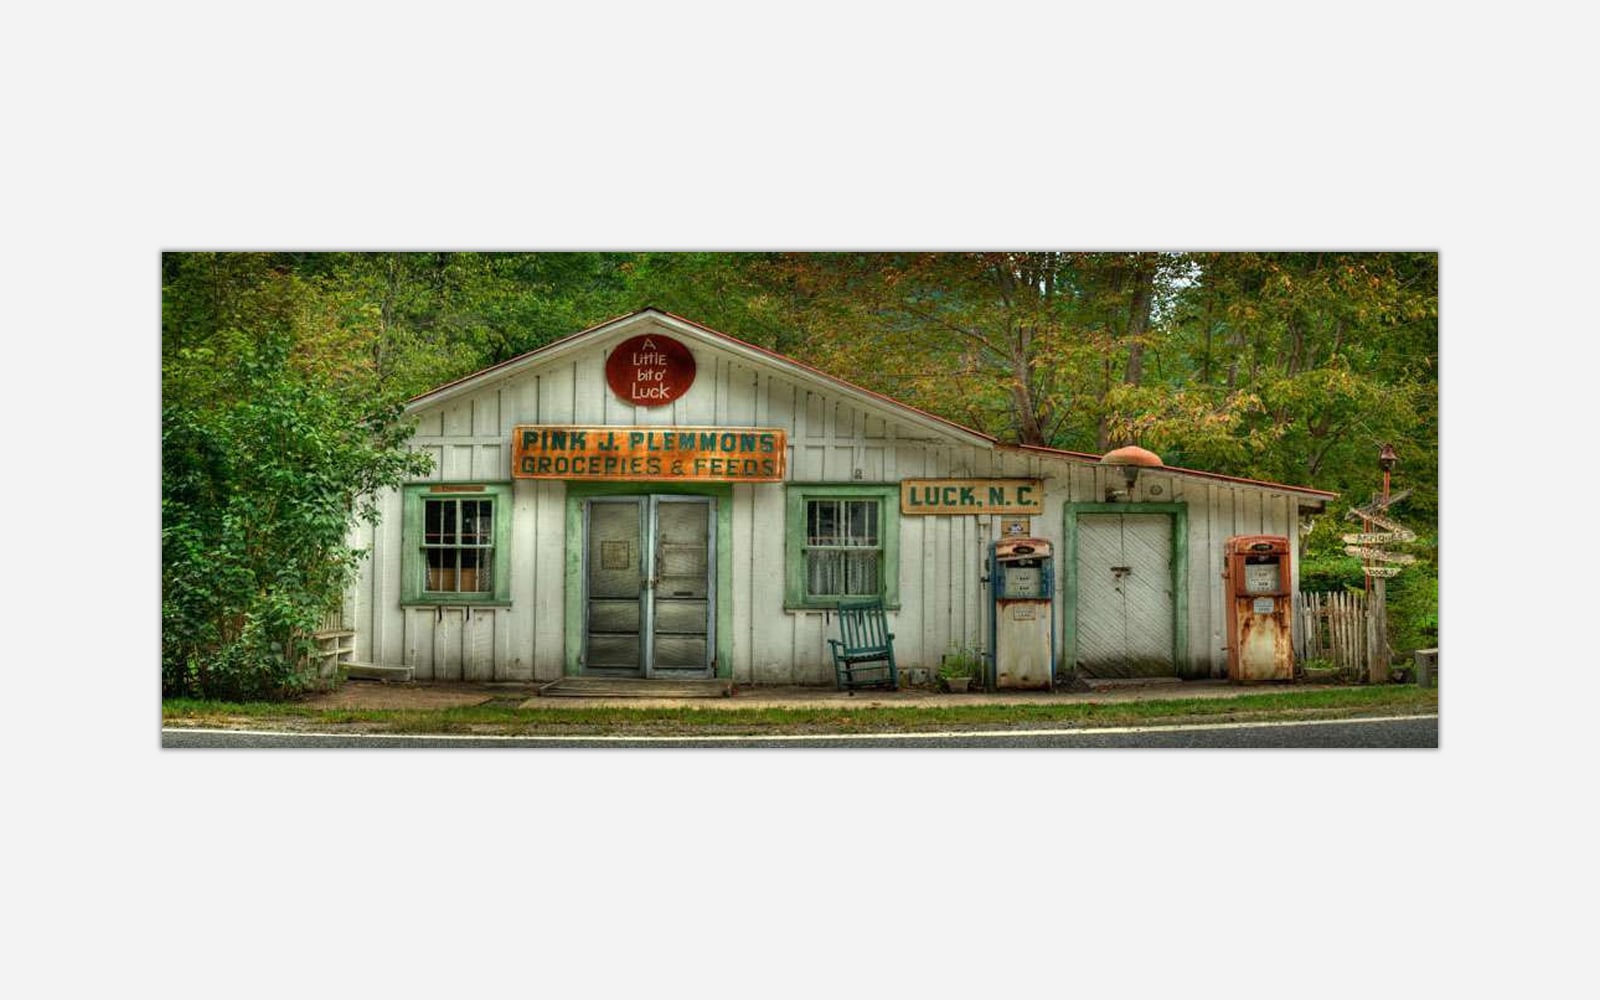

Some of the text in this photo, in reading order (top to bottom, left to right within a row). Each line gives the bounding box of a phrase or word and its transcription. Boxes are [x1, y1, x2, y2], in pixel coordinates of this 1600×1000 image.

[642, 338, 657, 350] A
[637, 369, 652, 381] bit
[632, 382, 670, 399] Luck
[523, 431, 775, 453] PINK J. PLEMMONS
[671, 459, 685, 475] &
[694, 457, 775, 476] FEEDS
[909, 486, 983, 507] LUCK,
